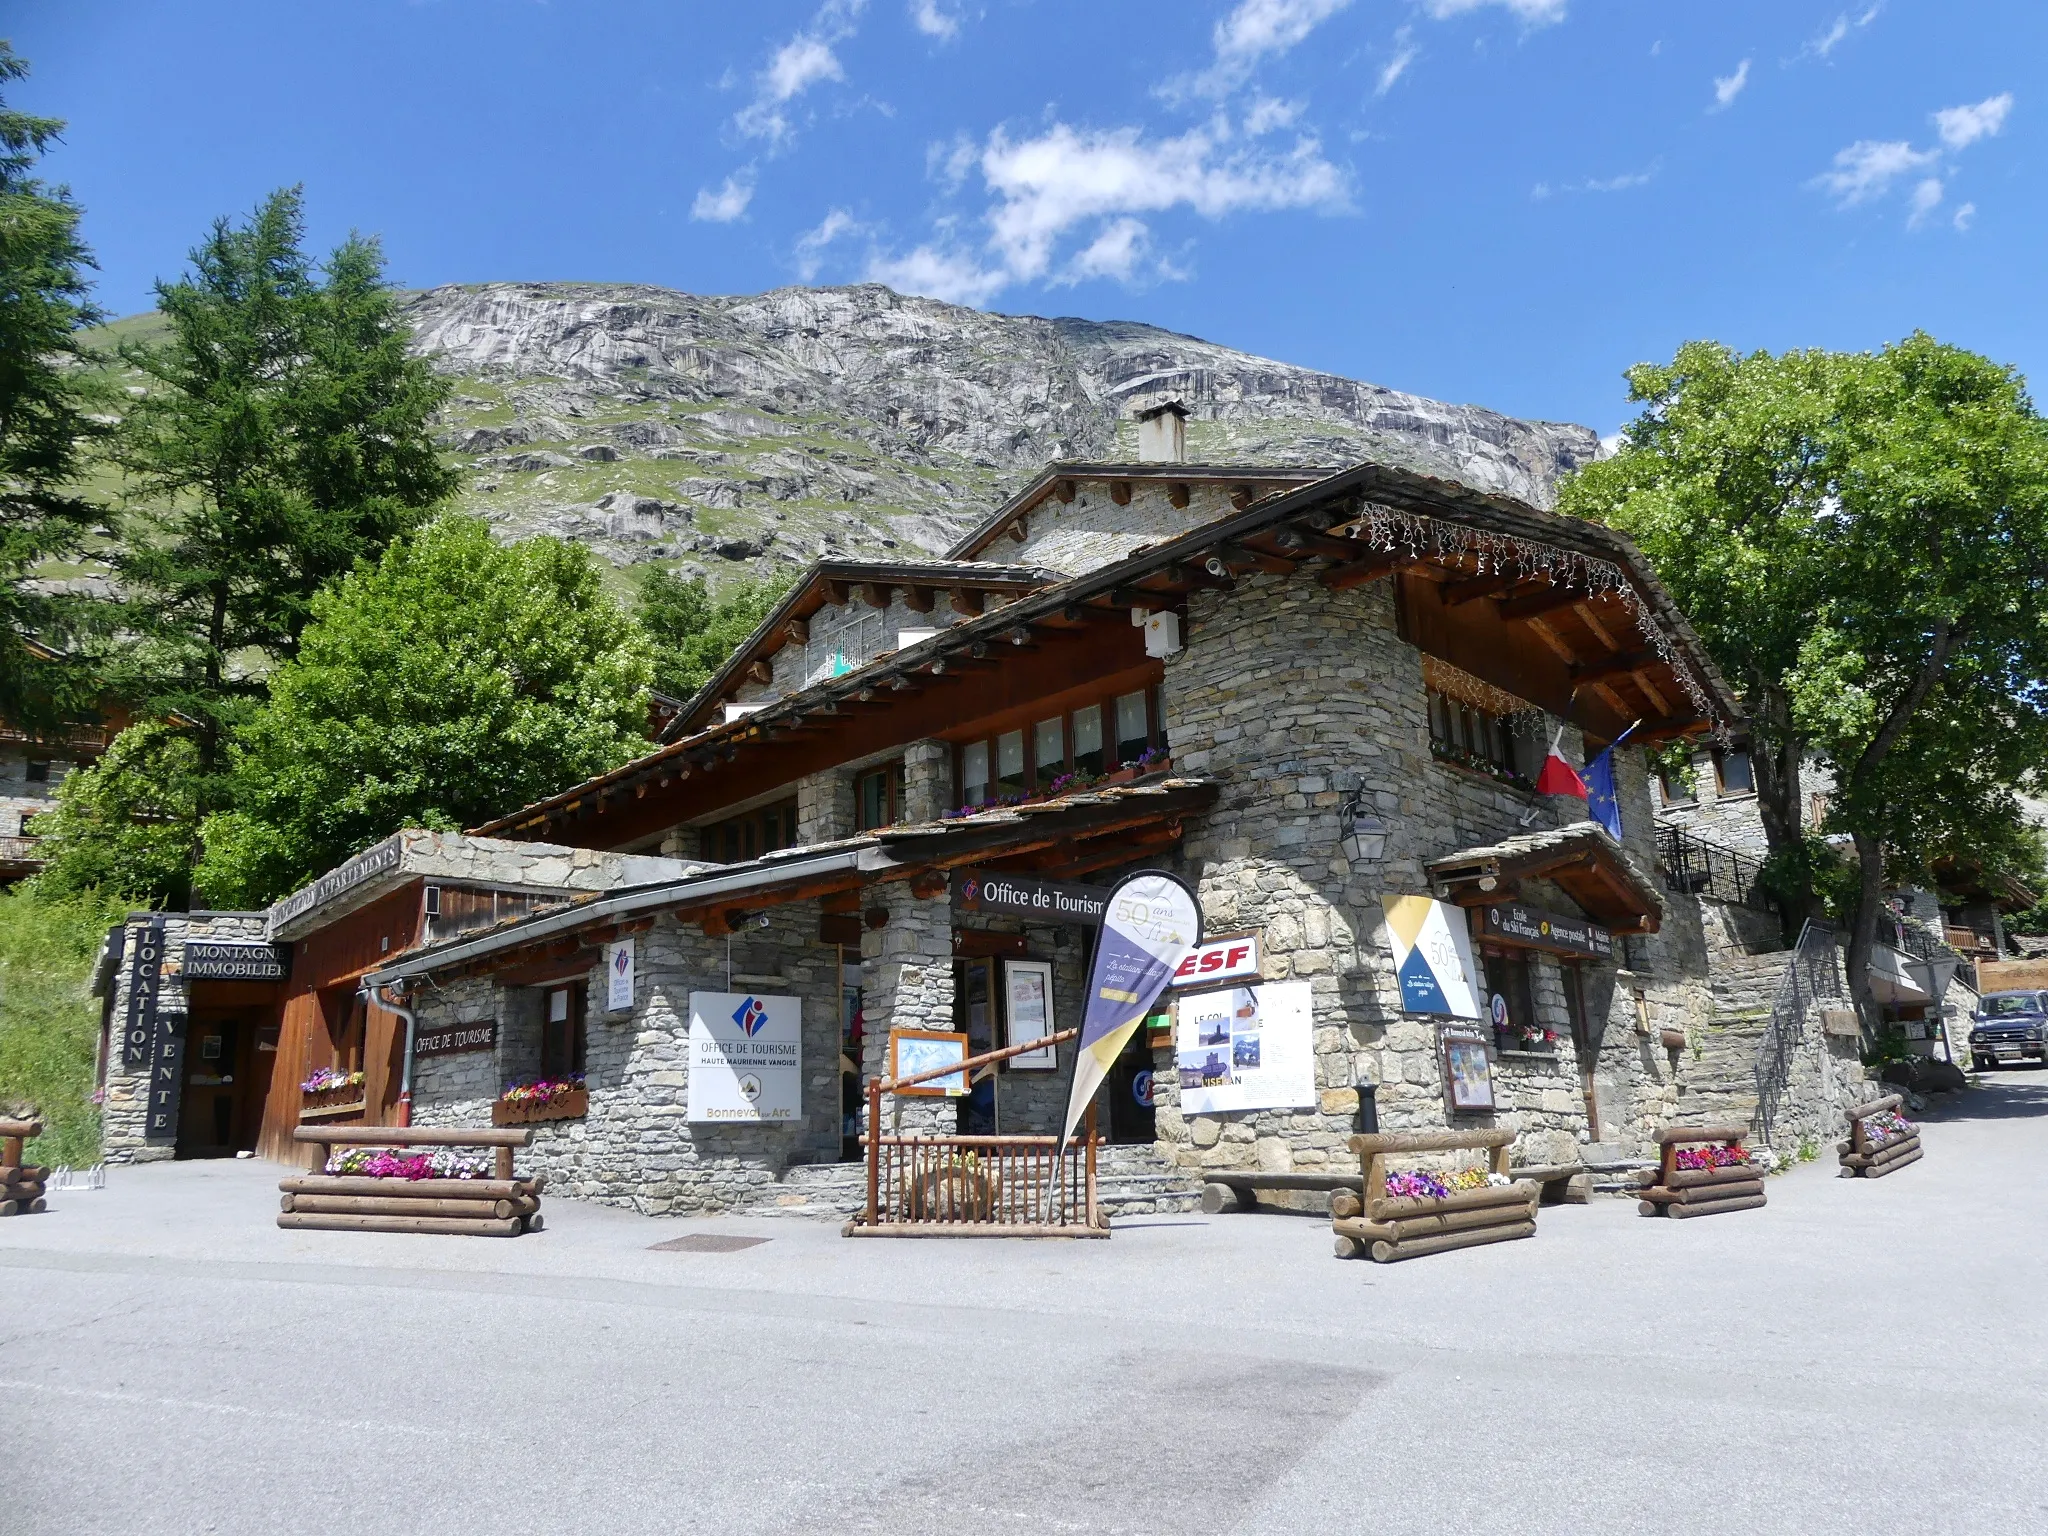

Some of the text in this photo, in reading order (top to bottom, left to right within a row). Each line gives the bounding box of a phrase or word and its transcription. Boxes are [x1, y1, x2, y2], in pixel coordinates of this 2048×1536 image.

[320, 844, 395, 898] APPARTEMENTS
[984, 882, 1104, 914] Office de Tourism
[1116, 899, 1149, 925] 50
[1152, 906, 1174, 918] ans
[1503, 918, 1540, 939] du Ski Français
[1551, 924, 1585, 943] Agence postale
[192, 945, 285, 961] MONTAGNE
[1173, 945, 1250, 977] ESF
[1430, 941, 1449, 967] 50
[187, 961, 287, 977] IMMOBILIER
[129, 931, 156, 1061] LOCATION
[416, 1028, 492, 1053] OFFICE DE TOURISME
[701, 1042, 797, 1055] OFFICE DE TOURISME
[726, 1058, 767, 1066] MAURIENNE
[154, 1021, 180, 1129] VENTE
[706, 1107, 760, 1118] Bonneval
[771, 1107, 791, 1117] Arc
